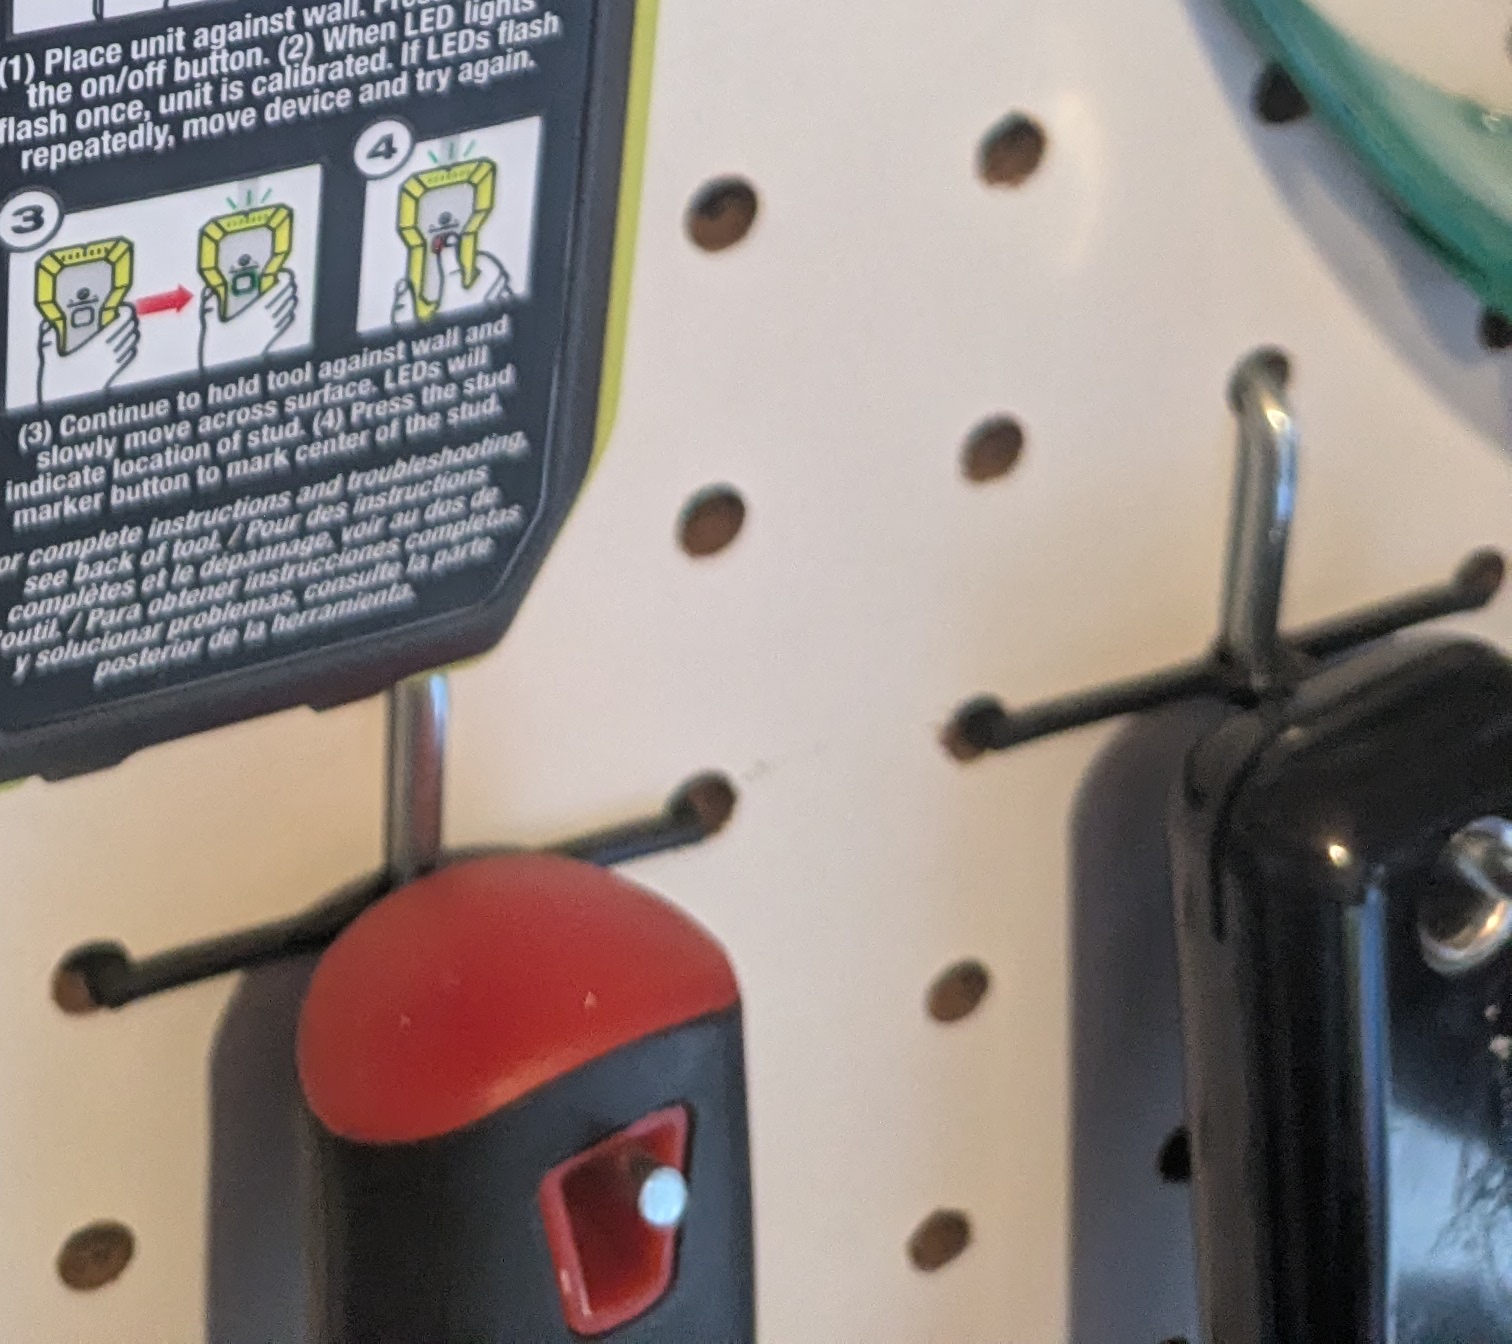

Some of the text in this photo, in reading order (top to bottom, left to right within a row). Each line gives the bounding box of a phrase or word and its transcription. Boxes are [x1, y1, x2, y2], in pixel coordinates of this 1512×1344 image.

[27, 82, 72, 109] the
[80, 59, 167, 99] on/off
[174, 46, 270, 82] button.
[279, 31, 314, 63] (2)
[322, 21, 396, 53] When
[404, 5, 455, 37] LED
[45, 43, 122, 75] Place
[131, 27, 186, 61] unit
[193, 5, 296, 50] against
[75, 99, 151, 131] once,
[158, 81, 214, 115] unit
[220, 77, 244, 102] is
[251, 47, 393, 97] calibrated.
[401, 40, 421, 66] If
[427, 29, 490, 61] LEDs
[498, 11, 561, 46] flash
[20, 49, 537, 173] repeatedly, move device and try again.
[366, 132, 397, 162] 4
[10, 203, 45, 234] 3
[18, 313, 512, 452] (3) Continue to hold tool against wall and
[37, 344, 489, 470] slowly move across surface. LEDs will
[5, 363, 517, 503] indicate location of stud. (4) Press the stud
[13, 392, 503, 529] marker button to mark center of the stud.
[24, 569, 69, 595] see
[73, 550, 135, 584] back
[140, 541, 169, 566] of
[172, 529, 223, 560] tool.
[246, 514, 302, 543] Pour
[306, 501, 349, 528] des
[353, 465, 489, 514] instructions
[28, 525, 144, 568] complete
[148, 490, 292, 542] instructions
[296, 473, 344, 506] and
[141, 567, 169, 593] et
[171, 563, 195, 587] le
[342, 515, 387, 544] voir
[390, 507, 421, 531] au
[424, 496, 467, 523] dos
[12, 653, 32, 684] y
[35, 621, 165, 671] solucionar
[85, 602, 143, 634] Para
[147, 578, 242, 617] obtener
[92, 636, 205, 687] posterior
[208, 626, 239, 653] de
